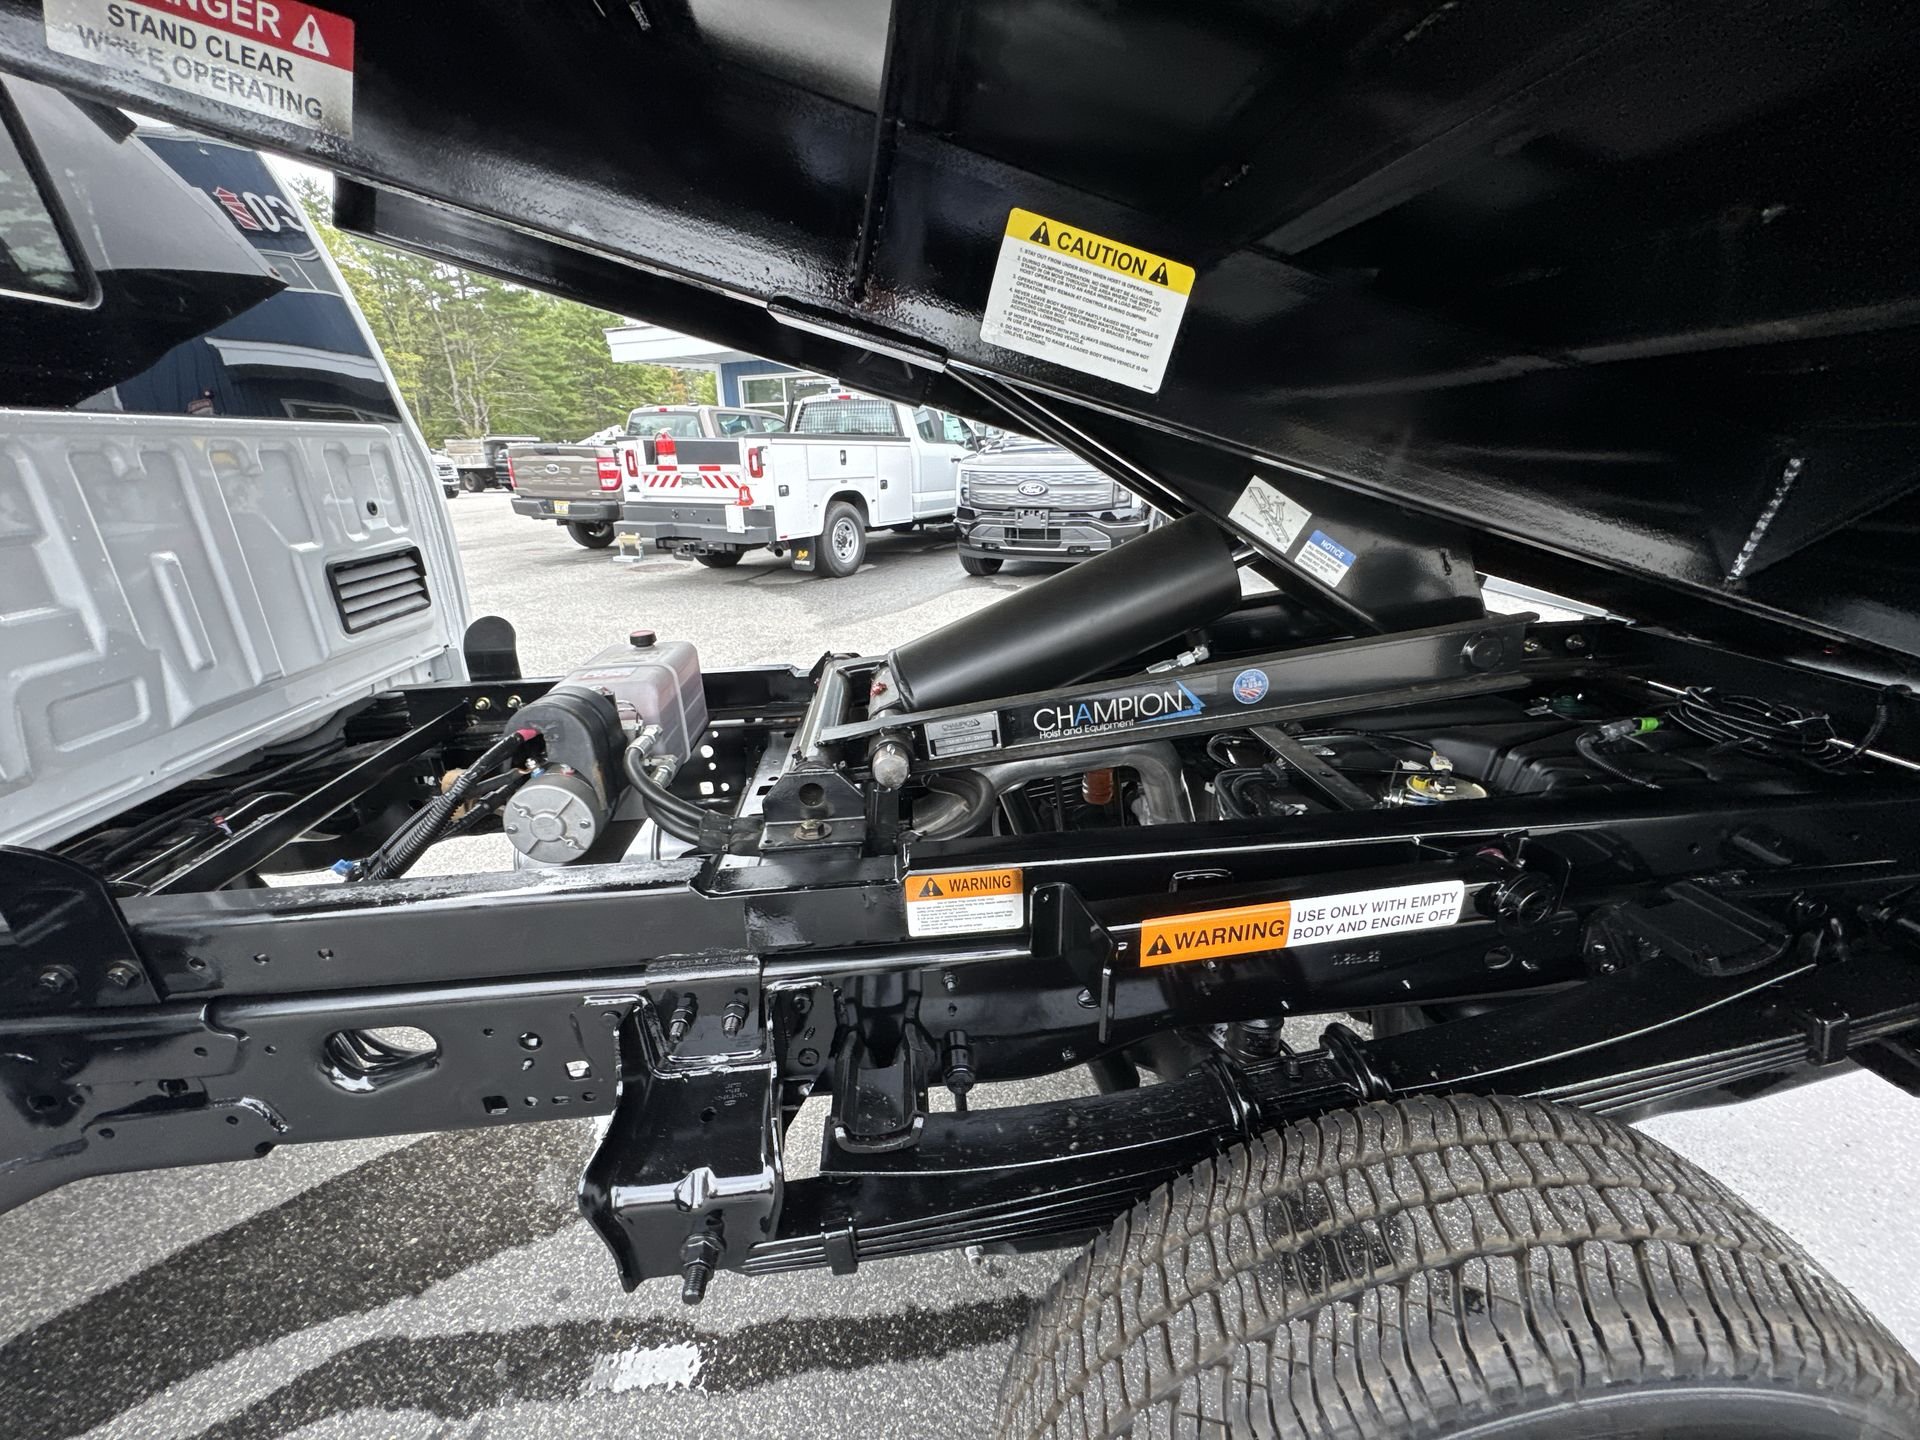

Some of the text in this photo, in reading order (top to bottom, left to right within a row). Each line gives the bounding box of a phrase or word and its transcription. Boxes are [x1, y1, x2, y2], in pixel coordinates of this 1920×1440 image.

[165, 0, 281, 38] GER
[108, 4, 294, 82] STAND CLEAR
[173, 56, 322, 120] OPERATING
[1057, 232, 1147, 276] CAUTION
[1321, 540, 1344, 559] NOTICE
[1033, 689, 1182, 731] CHAMPION
[1039, 719, 1134, 740] Hoist and Equipment
[948, 875, 1011, 892] WARNING
[1297, 892, 1458, 923] USE ONLY WITH EMPTY
[1174, 920, 1285, 950] WARNING
[1293, 908, 1456, 940] BODY AND ENGINE OFF
